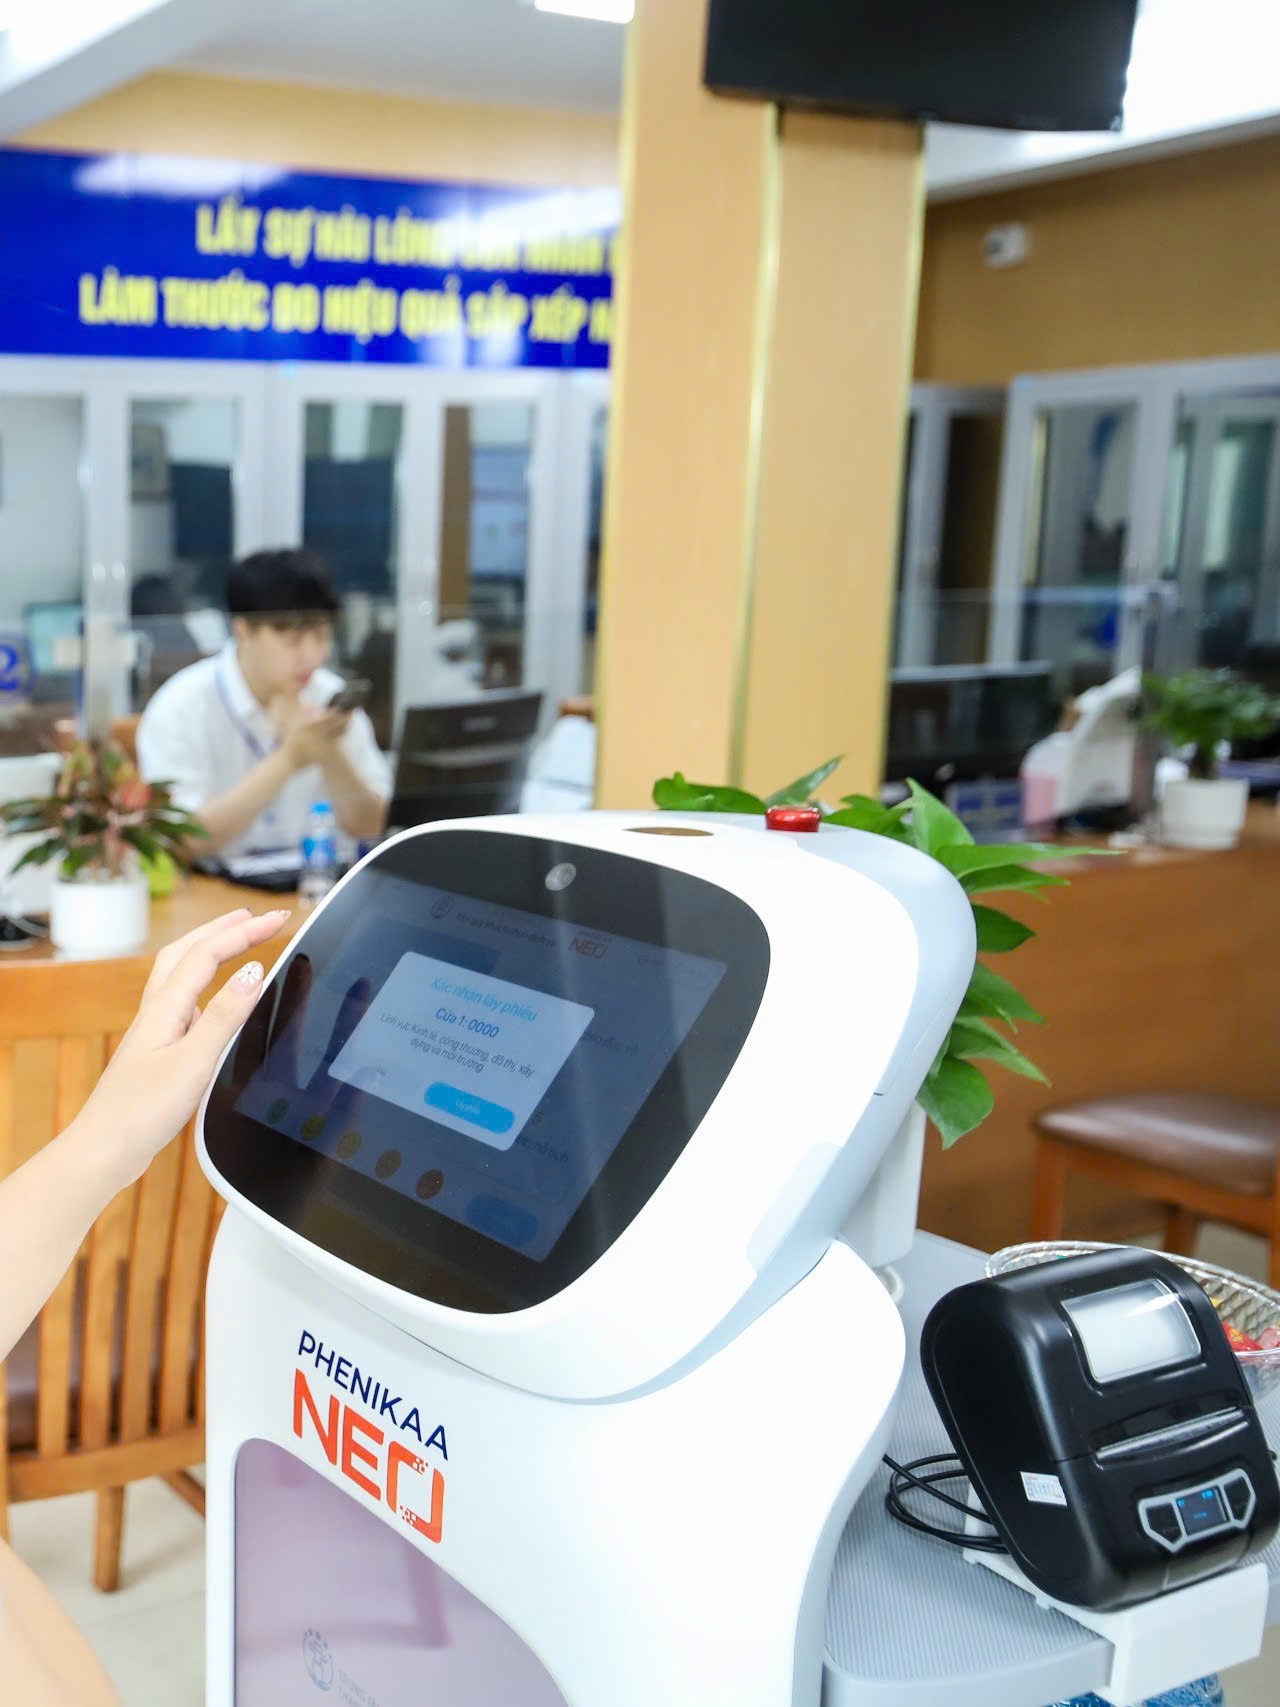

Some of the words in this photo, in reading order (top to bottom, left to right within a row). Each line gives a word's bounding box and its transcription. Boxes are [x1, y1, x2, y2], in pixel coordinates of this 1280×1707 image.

[79, 264, 157, 327] LÀM
[160, 268, 270, 331] THƯỚC
[322, 277, 398, 346] HIỆU
[293, 1367, 446, 1544] NEO
[298, 1329, 449, 1462] PHENIKAA
